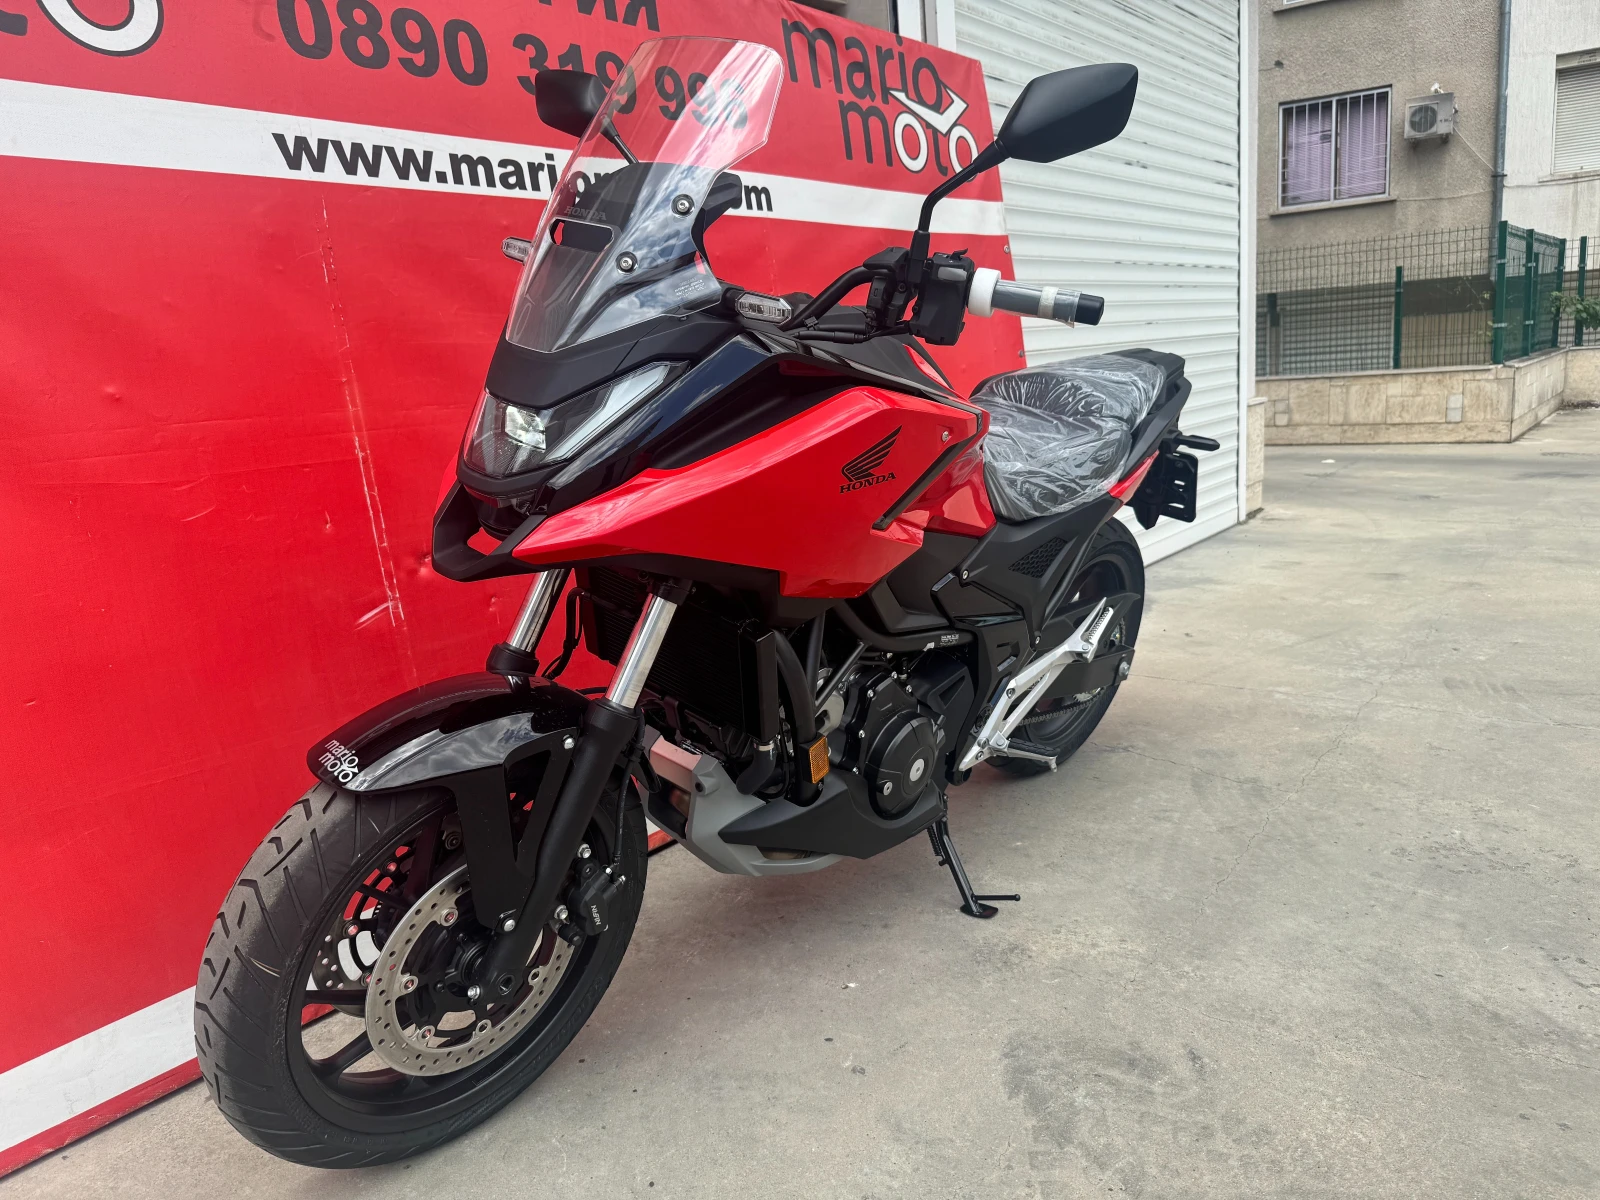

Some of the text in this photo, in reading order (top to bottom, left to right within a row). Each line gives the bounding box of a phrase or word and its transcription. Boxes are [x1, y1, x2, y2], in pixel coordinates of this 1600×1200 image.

[275, 0, 490, 87] 0890
[781, 17, 943, 113] mario
[838, 99, 979, 182] moto
[839, 471, 897, 494] HONDA
[318, 751, 353, 783] moto
[324, 739, 359, 767] mario
